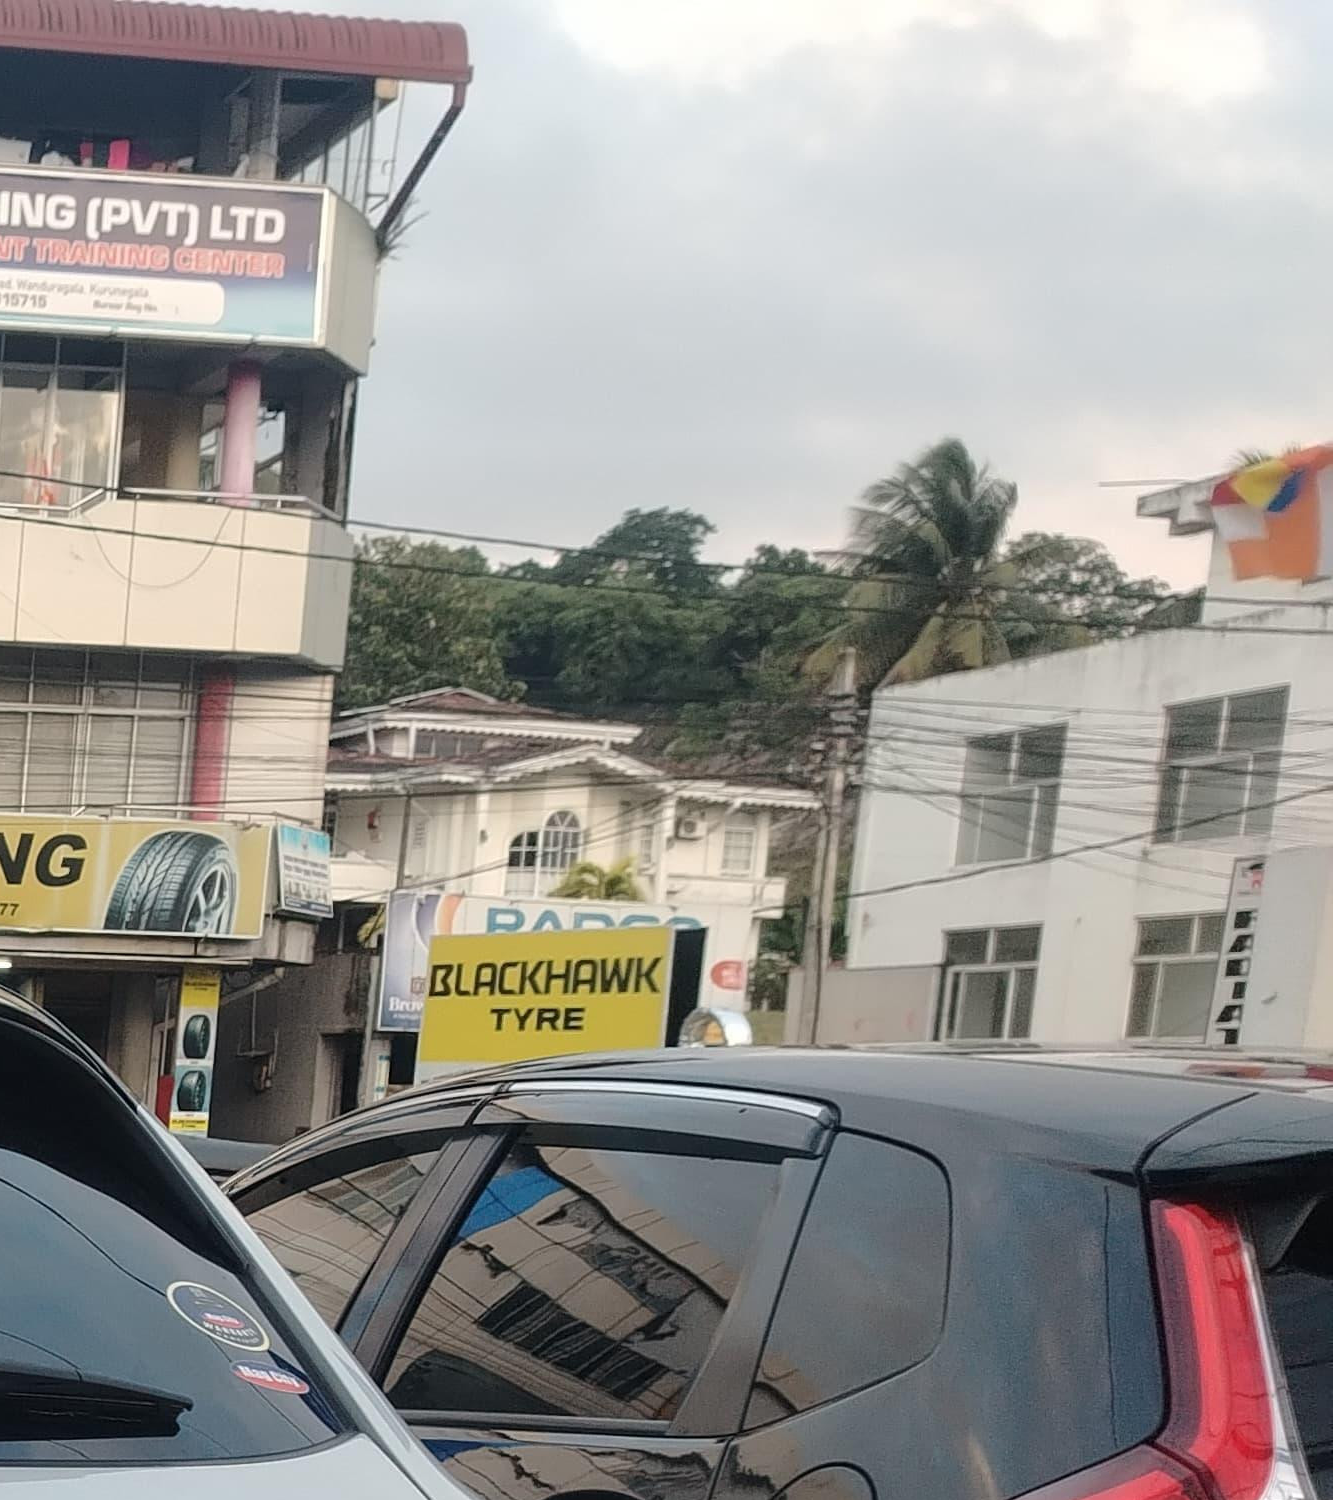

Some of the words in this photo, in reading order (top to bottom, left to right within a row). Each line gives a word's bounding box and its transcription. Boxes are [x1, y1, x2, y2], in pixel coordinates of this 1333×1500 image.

[86, 196, 200, 247] (PVT)
[209, 204, 286, 243] LTD
[33, 237, 170, 272] TRAINING
[173, 248, 285, 279] CENTER
[428, 956, 663, 998] BLACKHAWK
[490, 1006, 586, 1032] TYRE
